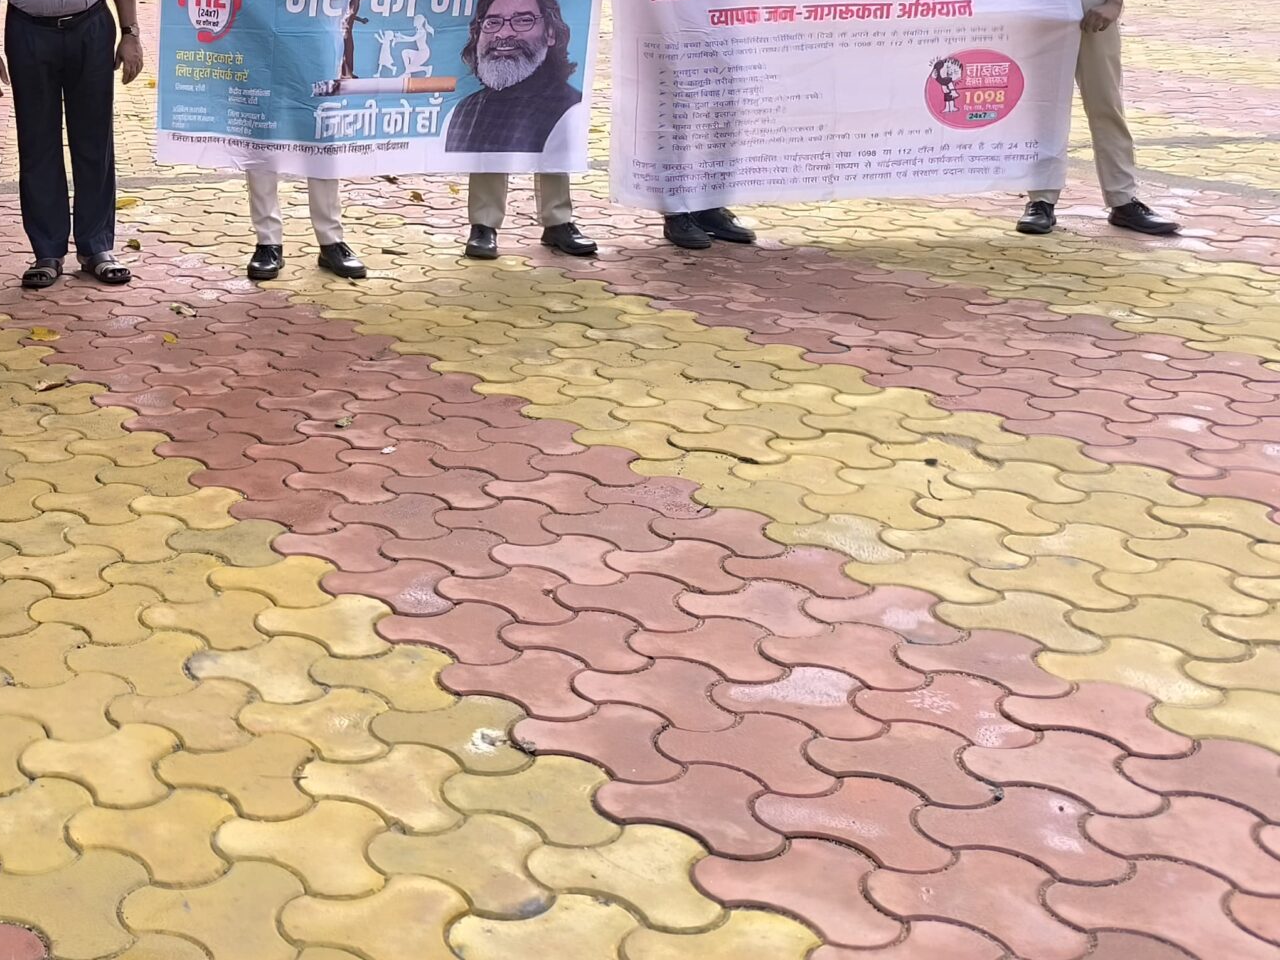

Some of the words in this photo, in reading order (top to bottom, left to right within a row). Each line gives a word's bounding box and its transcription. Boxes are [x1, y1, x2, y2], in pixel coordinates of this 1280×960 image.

[175, 49, 194, 62] नशा
[196, 48, 205, 62] से
[235, 51, 245, 66] के
[175, 64, 193, 77] लिए
[964, 89, 1005, 105] 1098
[313, 99, 379, 139] जिंदगी
[381, 98, 413, 134] को
[414, 92, 443, 134] हाँ
